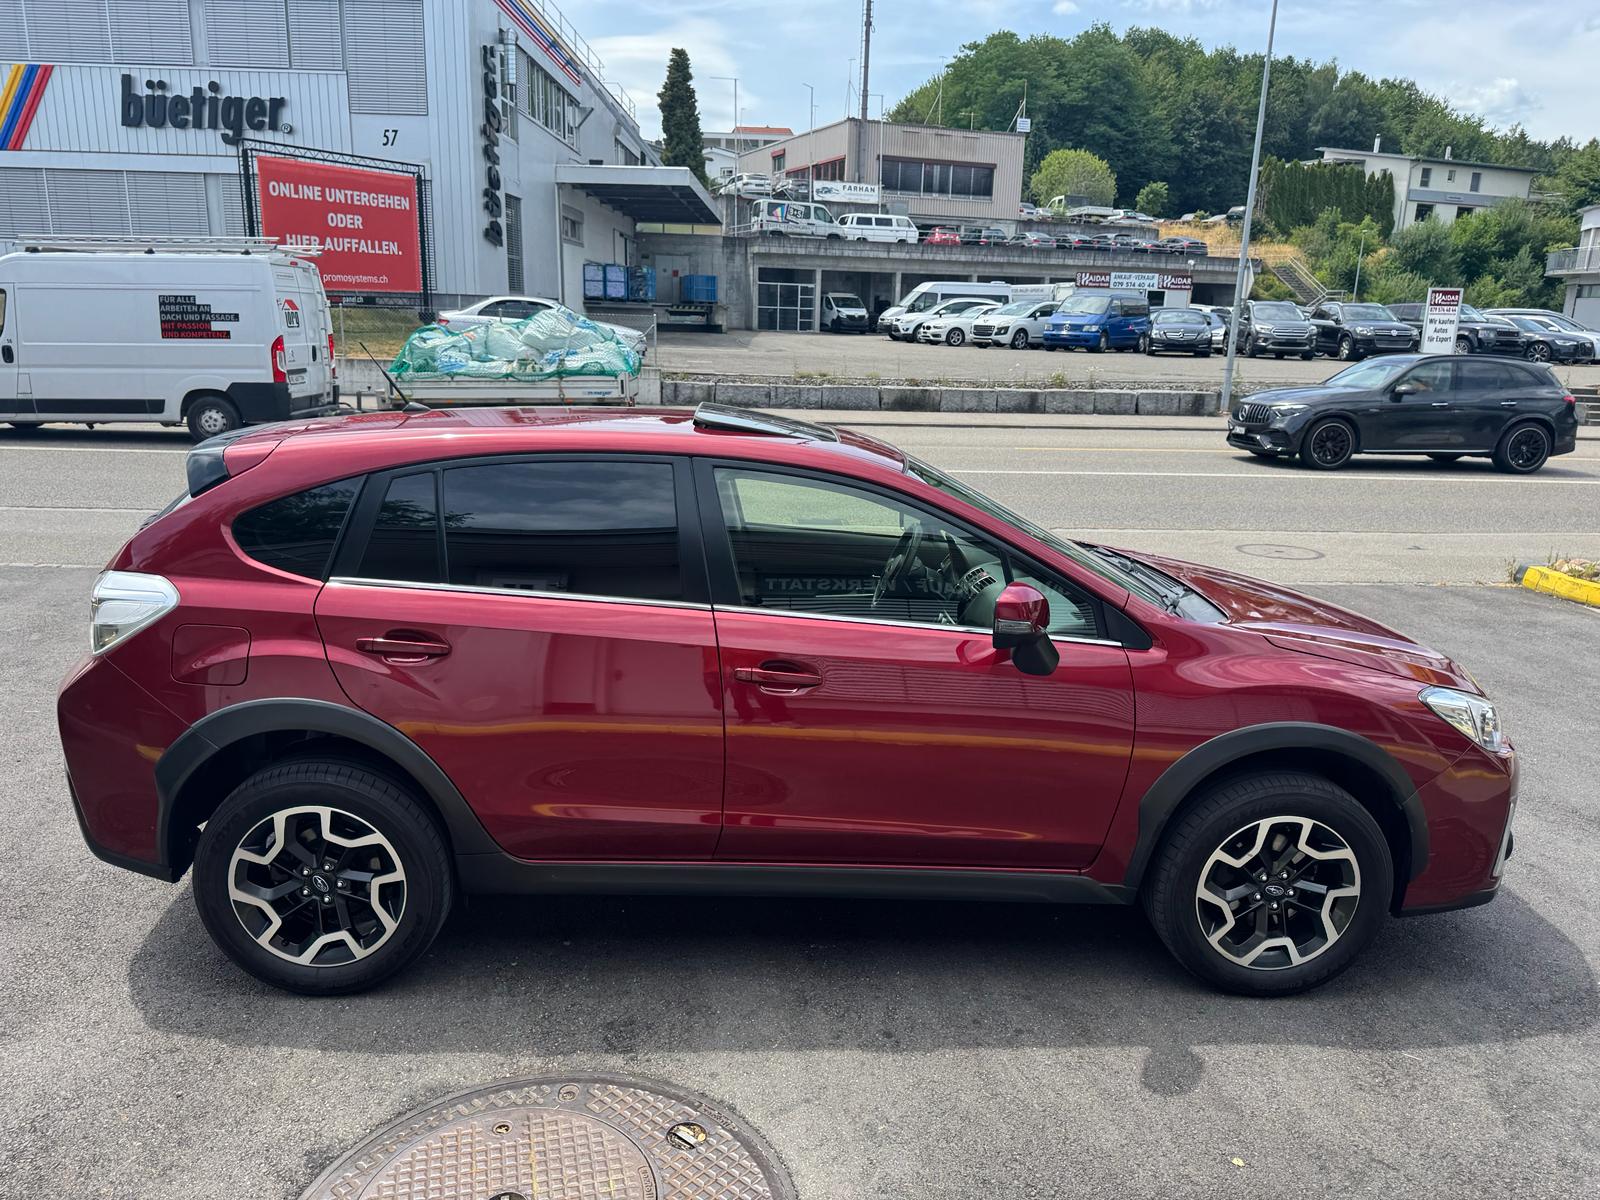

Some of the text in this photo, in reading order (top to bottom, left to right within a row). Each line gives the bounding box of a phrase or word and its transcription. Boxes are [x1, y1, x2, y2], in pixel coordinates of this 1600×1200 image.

[121, 73, 286, 145] büetiger
[382, 129, 399, 147] 57
[842, 184, 876, 193] FARHAN
[268, 181, 410, 210] ONLINE UNTERGEHEN
[327, 212, 364, 229] ODER
[285, 233, 403, 256] HIER AUFFALLEN.
[323, 273, 389, 284] promosystems.ch
[1081, 272, 1110, 286] HAIDAR
[1163, 275, 1192, 288] HAIDAR
[160, 295, 196, 304] FÜR ALLE
[160, 304, 210, 313] ARBEITEN AN
[161, 313, 238, 322] DACH UND FASSADE.
[161, 322, 211, 330] MIT PASSION
[1435, 336, 1452, 344] Export
